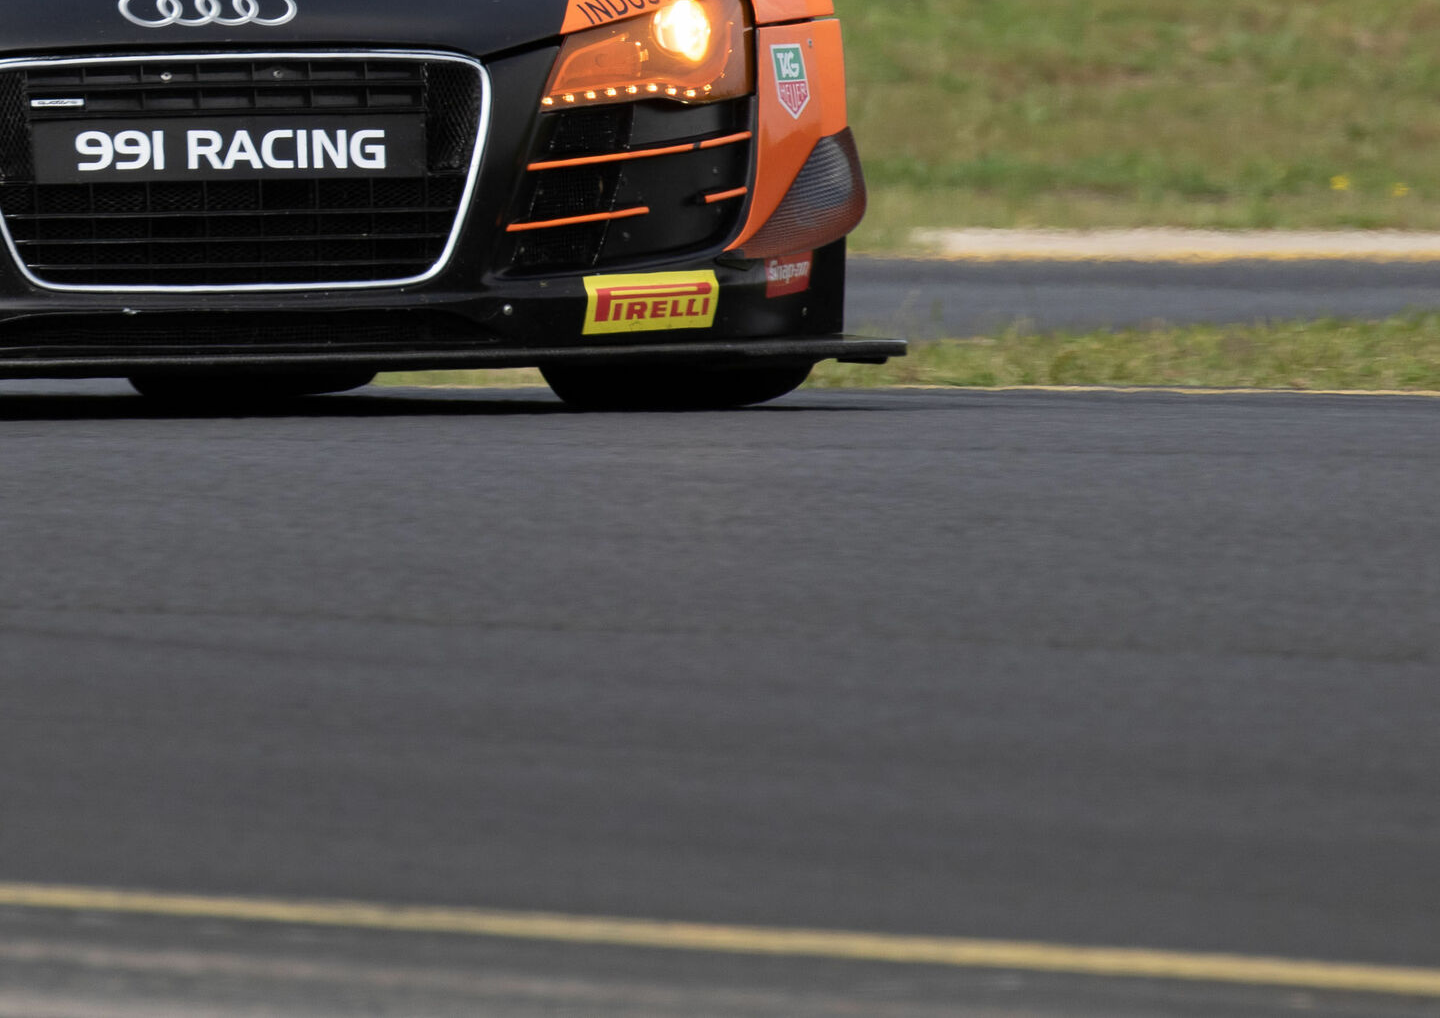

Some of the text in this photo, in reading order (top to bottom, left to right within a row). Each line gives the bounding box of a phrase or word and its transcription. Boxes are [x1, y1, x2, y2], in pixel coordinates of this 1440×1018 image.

[776, 50, 800, 78] TAG
[779, 83, 809, 112] HEUER
[187, 129, 386, 170] RACING
[593, 282, 712, 323] PIRELLI
